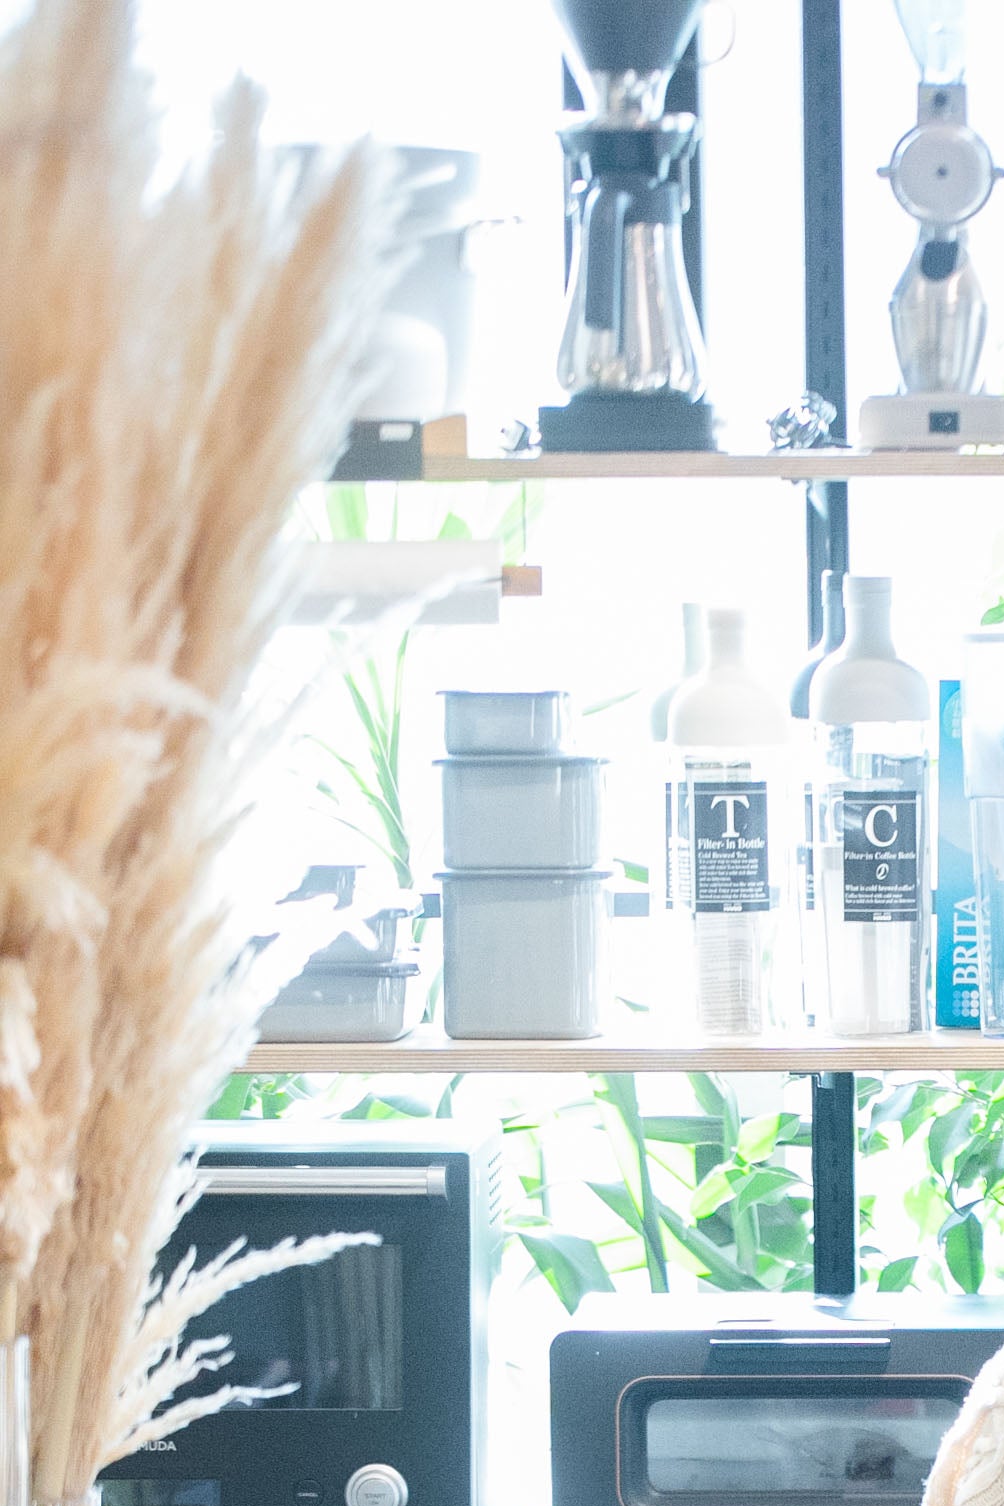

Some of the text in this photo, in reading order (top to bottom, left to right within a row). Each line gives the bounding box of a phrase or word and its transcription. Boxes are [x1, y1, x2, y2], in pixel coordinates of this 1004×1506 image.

[710, 794, 750, 838] T
[864, 804, 899, 848] C
[738, 837, 765, 849] Bottle
[952, 895, 979, 986] BRITA
